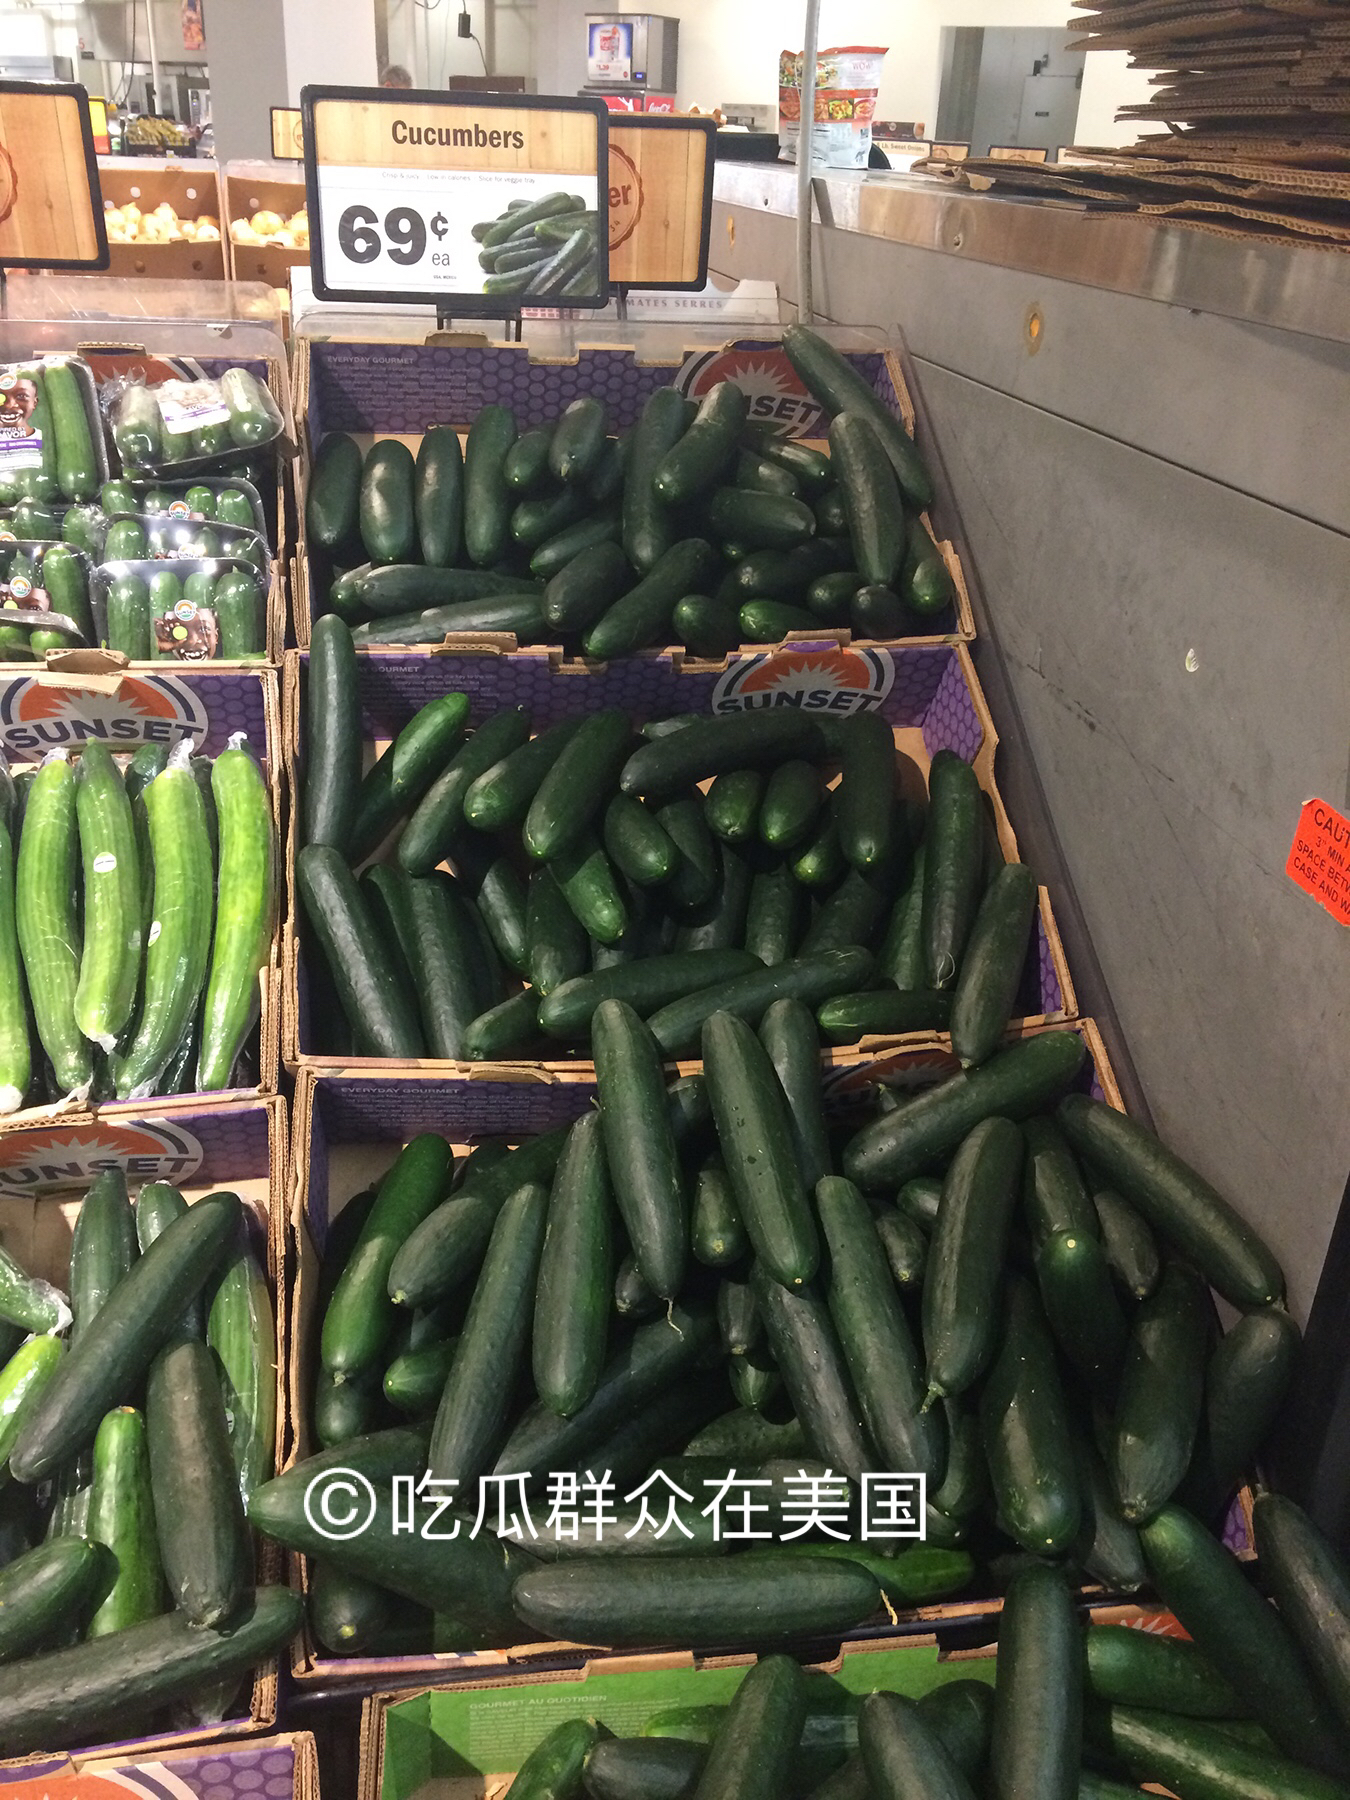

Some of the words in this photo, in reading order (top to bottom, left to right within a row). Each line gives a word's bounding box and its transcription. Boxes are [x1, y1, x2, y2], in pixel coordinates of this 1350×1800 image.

[391, 120, 525, 149] Cucumbers
[432, 252, 450, 266] ea
[608, 299, 667, 307] TMATES
[674, 299, 723, 309] SERRES
[327, 356, 370, 364] EVERYDAY
[717, 689, 883, 715] SUNSET
[5, 718, 205, 748] SUNSET
[1297, 840, 1326, 872] SPACE
[1327, 845, 1345, 867] MIN
[1294, 857, 1318, 884] CASE
[1319, 880, 1339, 903] AND
[0, 1158, 198, 1185] UNSET
[469, 1700, 525, 1711] GOURMET
[528, 1697, 544, 1706] AU
[546, 1695, 608, 1704] QUOTIDIEN
